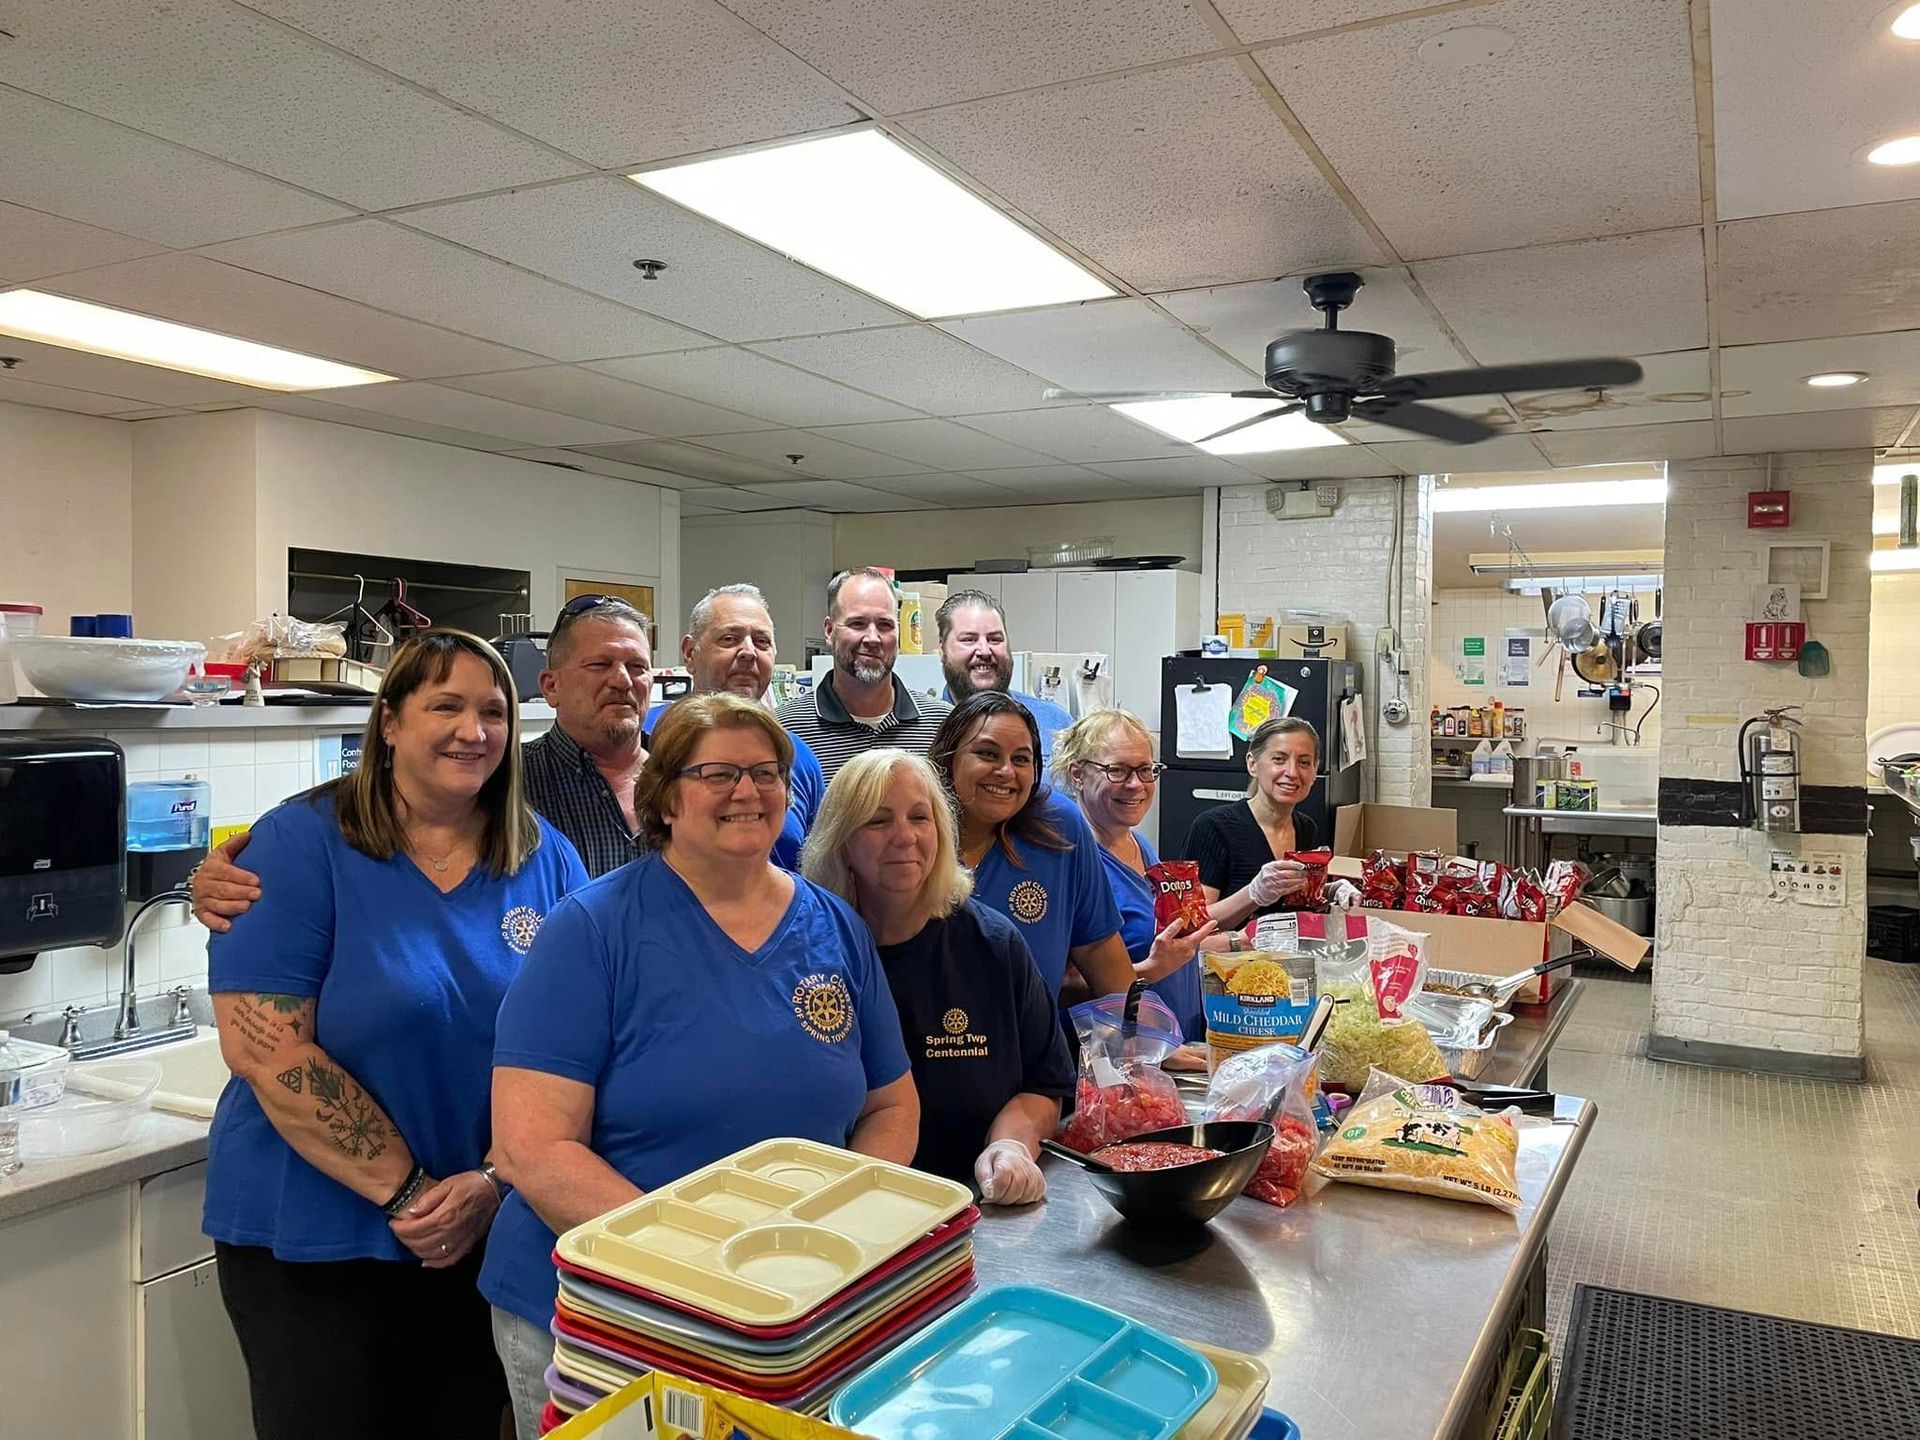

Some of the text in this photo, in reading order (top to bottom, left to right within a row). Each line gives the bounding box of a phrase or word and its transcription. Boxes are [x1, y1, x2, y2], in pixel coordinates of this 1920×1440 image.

[342, 760, 358, 769] Foo
[501, 905, 527, 929] ROTARY
[792, 973, 851, 1004] ROTARY CLUB
[1239, 996, 1275, 1004] KIRKLAND
[794, 1007, 805, 1019] OF
[801, 1020, 830, 1043] SPRING
[1212, 1010, 1303, 1027] MILD CHEDDAR
[1238, 1027, 1276, 1036] CHEESE
[925, 1033, 987, 1046] Spring Twp
[925, 1046, 988, 1058] Centennial
[1443, 1175, 1458, 1183] NET
[1473, 1182, 1479, 1190] 5
[1481, 1184, 1491, 1192] LB
